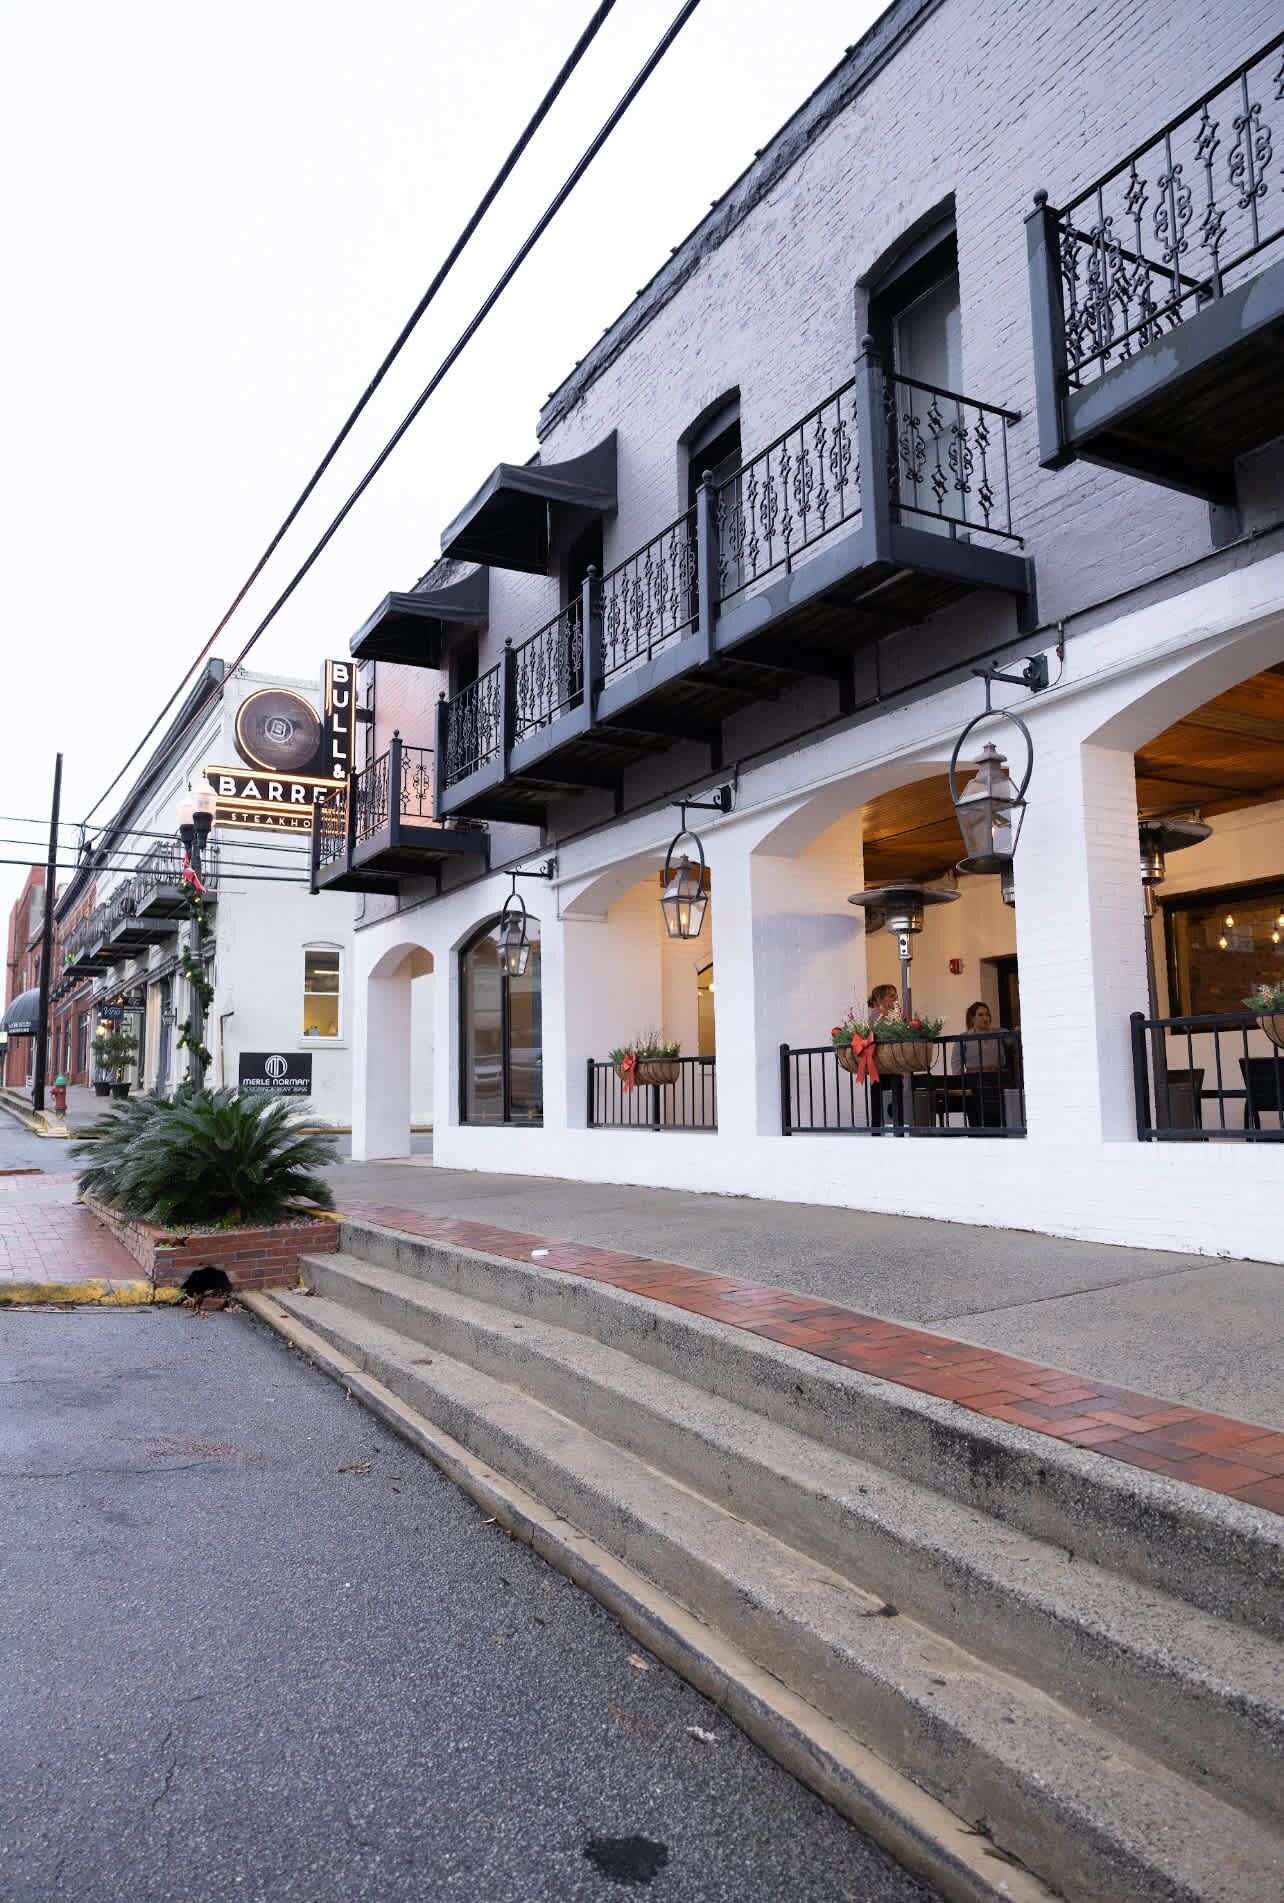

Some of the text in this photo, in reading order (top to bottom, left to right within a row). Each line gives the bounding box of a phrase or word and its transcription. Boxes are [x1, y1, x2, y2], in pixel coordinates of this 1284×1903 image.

[333, 664, 349, 779] BULL &
[231, 813, 333, 829] STEAKHO
[243, 1078, 309, 1086] MERLE NORMAN
